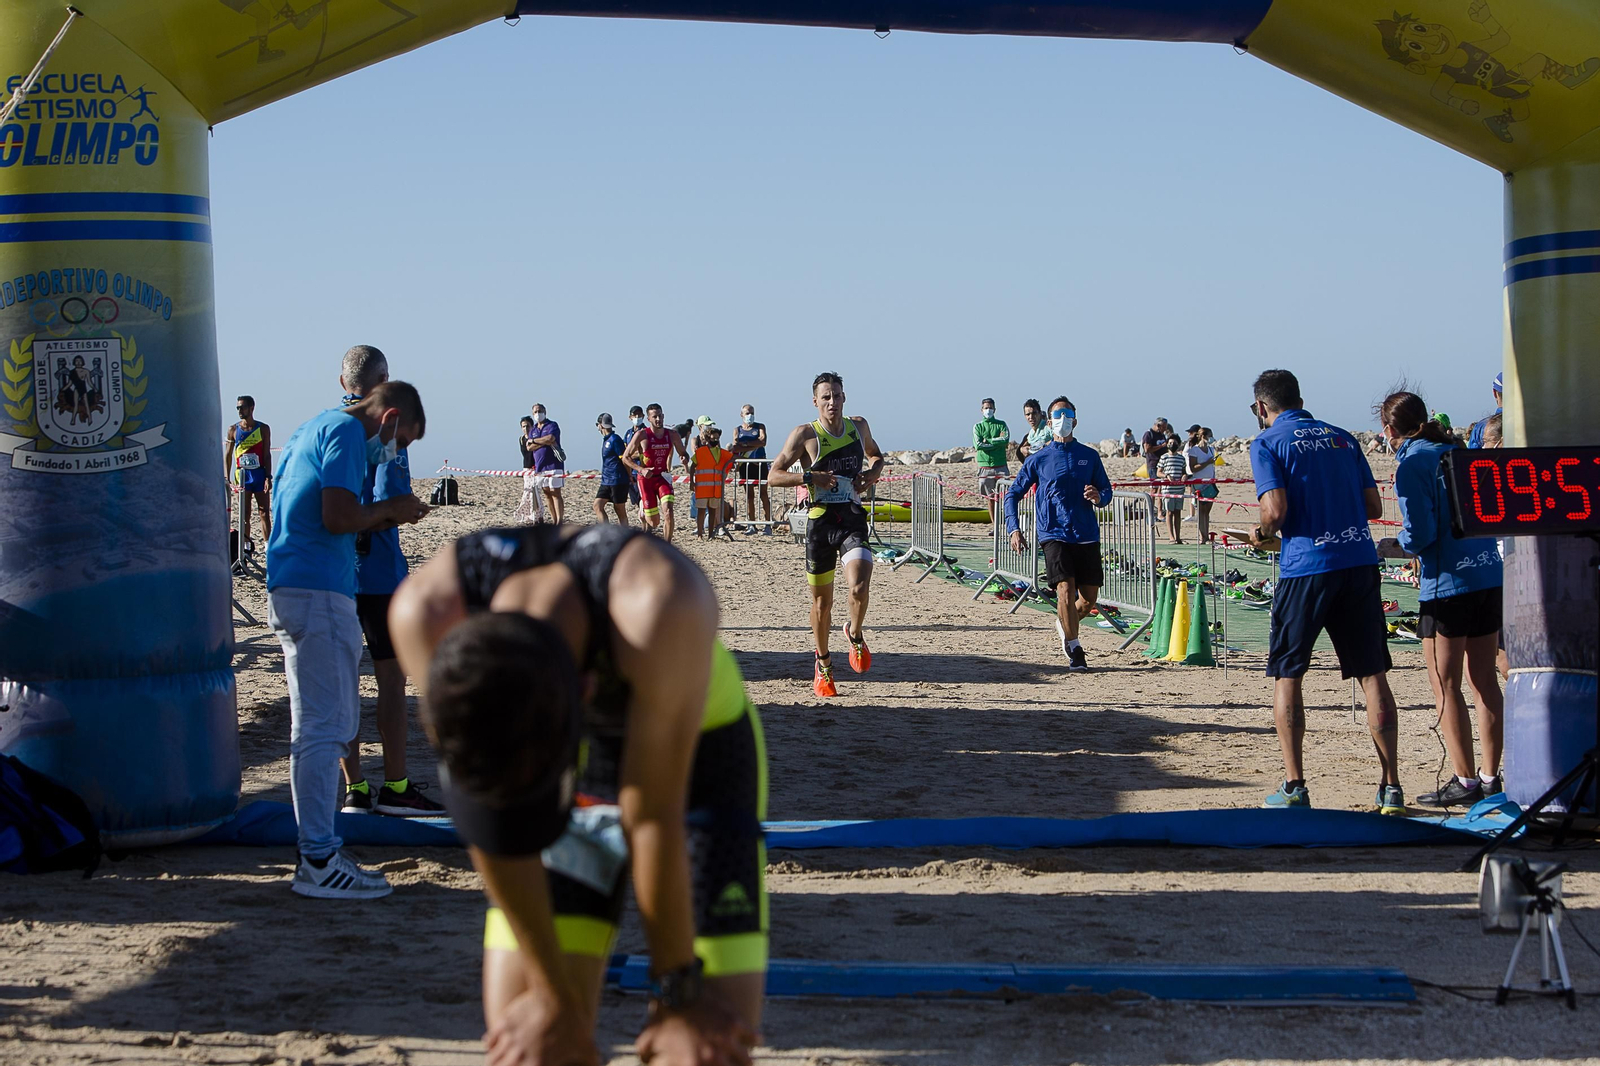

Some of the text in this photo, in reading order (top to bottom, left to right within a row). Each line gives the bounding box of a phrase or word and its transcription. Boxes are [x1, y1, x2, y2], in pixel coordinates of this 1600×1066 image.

[6, 73, 127, 94] ESCUELA
[0, 122, 159, 168] OLIMPO
[113, 272, 172, 321] OLIMPO
[46, 340, 109, 350] ATLETISMO
[37, 360, 48, 410] CLUB DE
[111, 361, 121, 402] OLIMPO
[60, 433, 104, 446] CADIZ
[1293, 427, 1339, 438] OFICIAL
[1290, 436, 1354, 454] TRIATLON
[25, 451, 140, 470] Fundado 1 Abril 1968
[828, 456, 858, 471] MONTERO
[1469, 457, 1600, 523] 09:5
